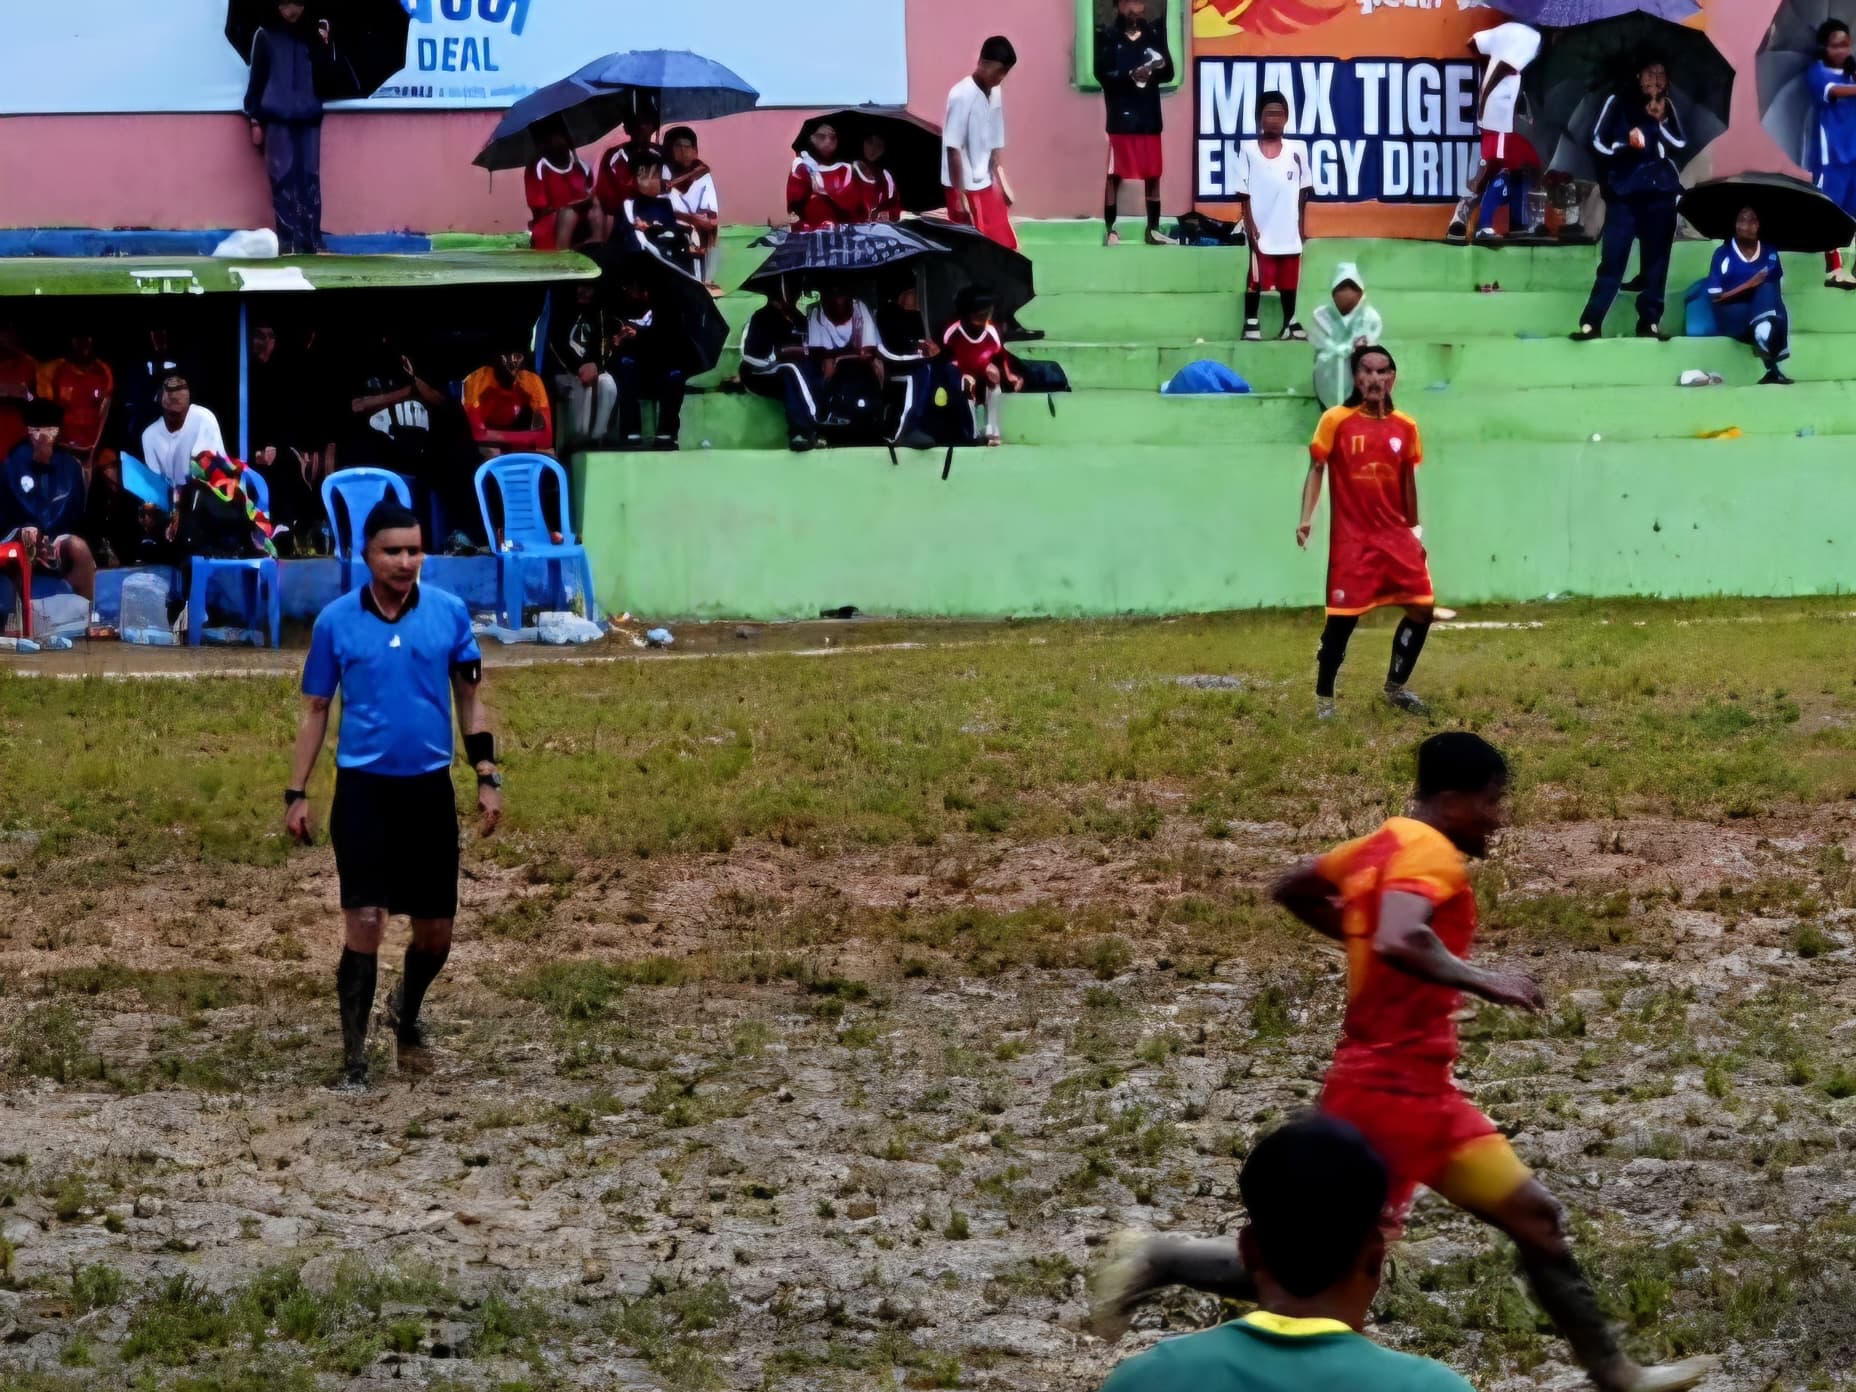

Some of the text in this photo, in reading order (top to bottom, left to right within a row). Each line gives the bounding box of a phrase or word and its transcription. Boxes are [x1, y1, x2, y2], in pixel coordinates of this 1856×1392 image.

[417, 37, 499, 72] DEAL
[1200, 61, 1479, 136] MAX TIGE
[1198, 139, 1482, 197] EGY DRIN
